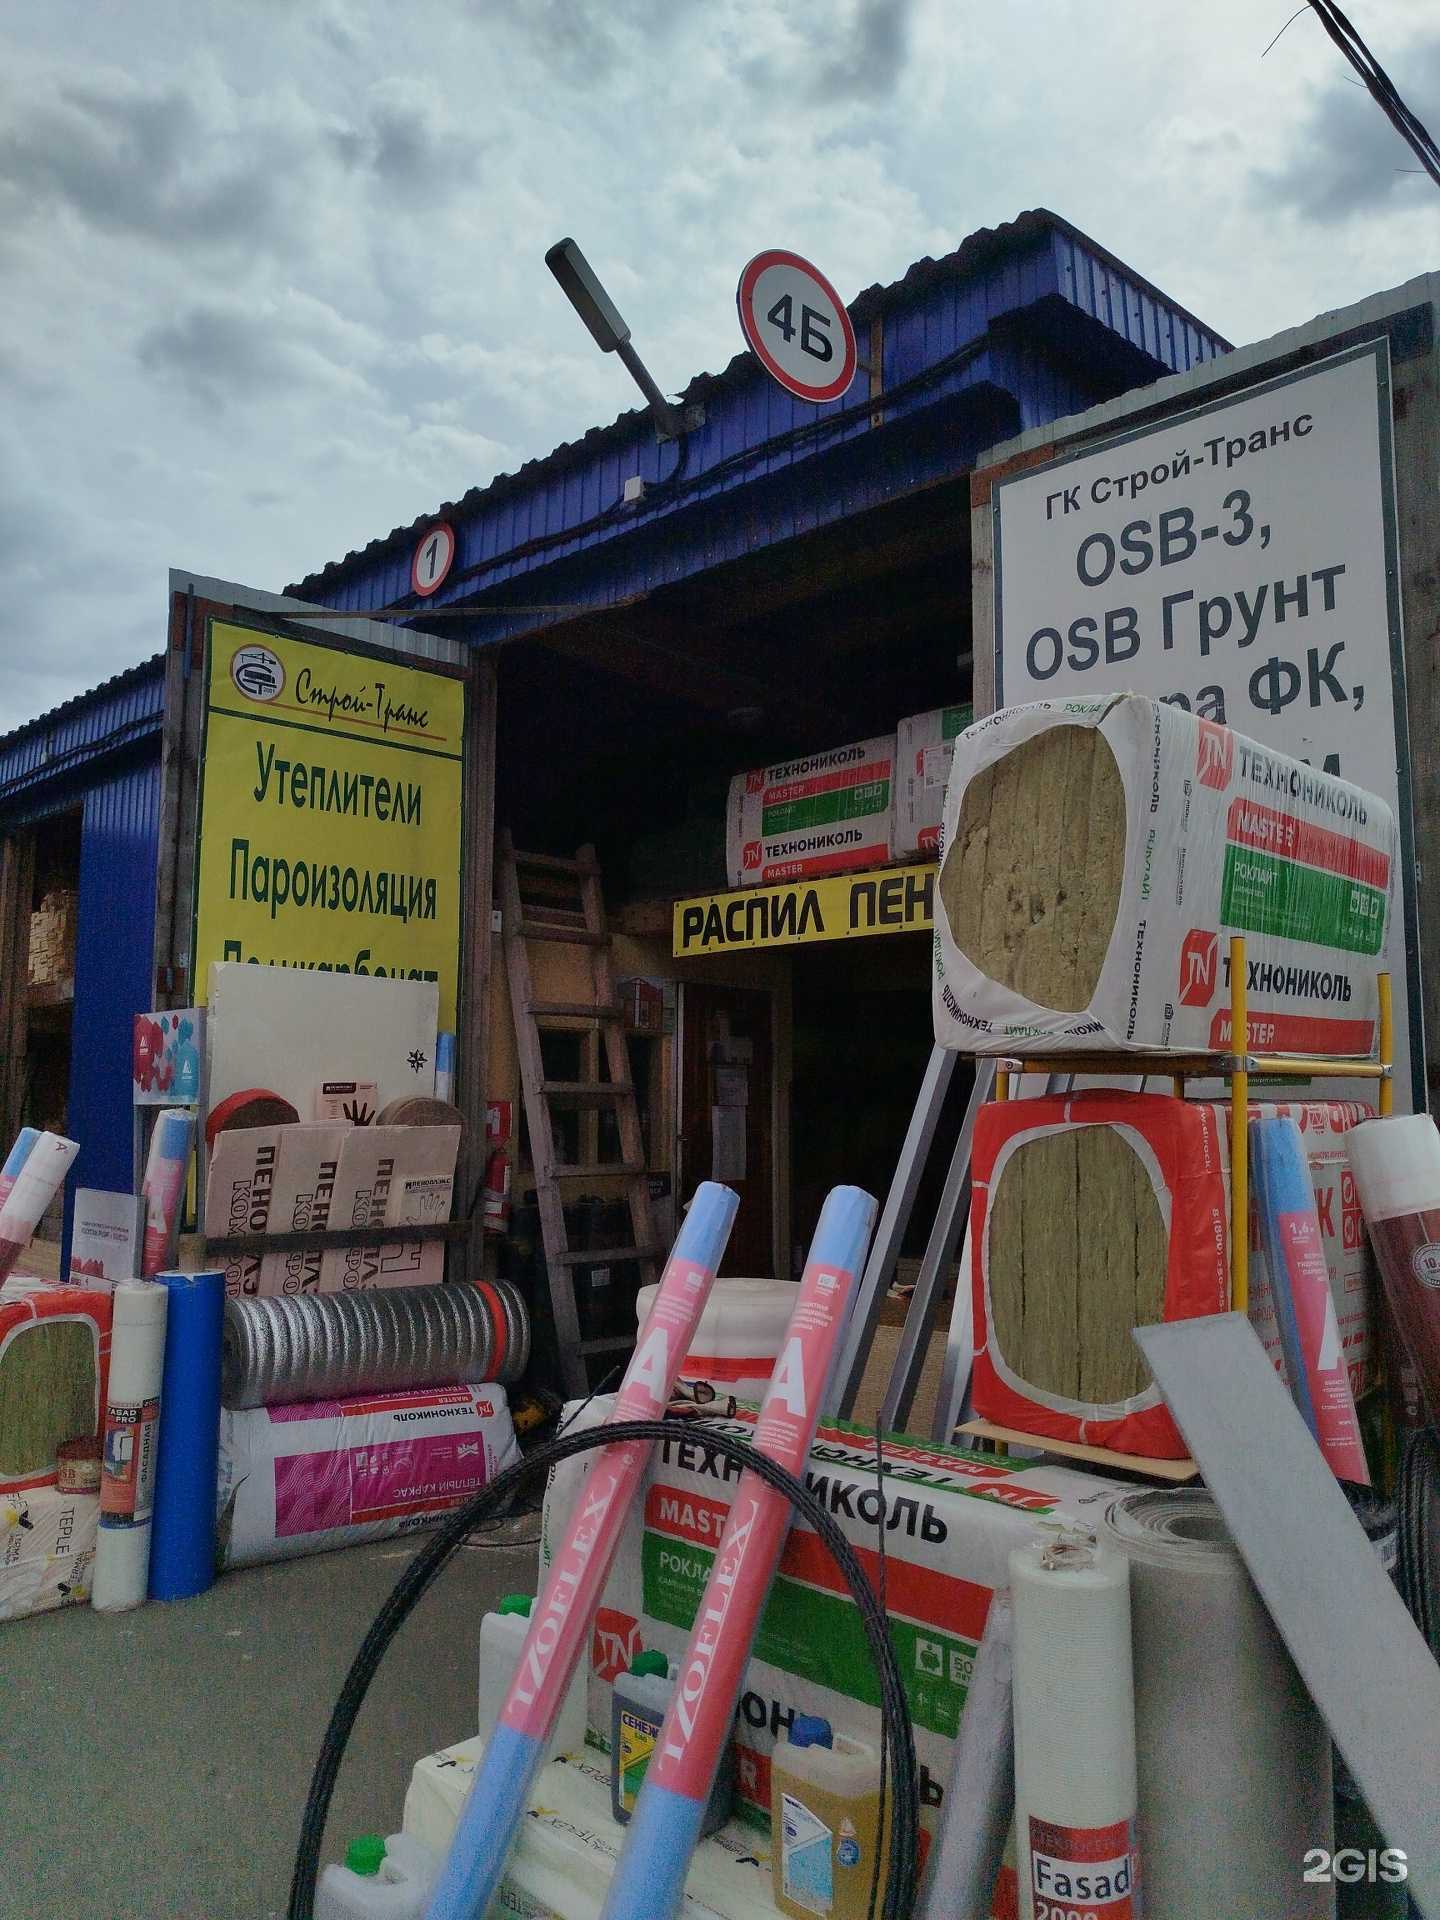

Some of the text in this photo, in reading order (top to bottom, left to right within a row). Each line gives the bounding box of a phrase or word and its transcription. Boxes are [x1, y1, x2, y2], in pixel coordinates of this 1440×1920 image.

[767, 294, 833, 363] 4Б
[1046, 413, 1314, 520] ГК Строй-Транс
[425, 538, 439, 580] 1
[1075, 489, 1272, 587] OSB-3,
[1025, 564, 1347, 681] OSB Грунт
[295, 667, 430, 732] Строй-Транс
[1247, 641, 1365, 715] ФК,
[253, 740, 422, 826] Утеплители
[767, 747, 866, 781] ТЕХНОНИКОЛЬ
[768, 784, 805, 800] MASTER
[1239, 746, 1368, 826] ТЕХНОНИКОЛЬ
[765, 828, 863, 859] ТЕХНОНИКОЛЬ
[767, 864, 803, 878] MASTER
[229, 838, 438, 924] Пароизоляция
[682, 872, 935, 948] РАСПИЛ ПЕН
[1223, 956, 1352, 1003] ТХНОНИКОЛЬ
[1219, 1019, 1275, 1045] MSTER
[627, 1326, 669, 1405] A
[765, 1336, 807, 1418] A
[393, 1406, 475, 1422] ТЕХНОНИКОЛЬ
[392, 1482, 437, 1498] КАРКАС
[659, 1436, 948, 1545] ТЕХНИКОЛЬ
[659, 1496, 727, 1538] MAST
[55, 1507, 75, 1554] TEPLE
[508, 1476, 619, 1714] IZOFLEX
[659, 1551, 713, 1583] РОКЛА
[657, 1499, 761, 1771] IZOFLEX
[954, 1659, 974, 1674] 50
[1036, 1857, 1131, 1901] Fasad
